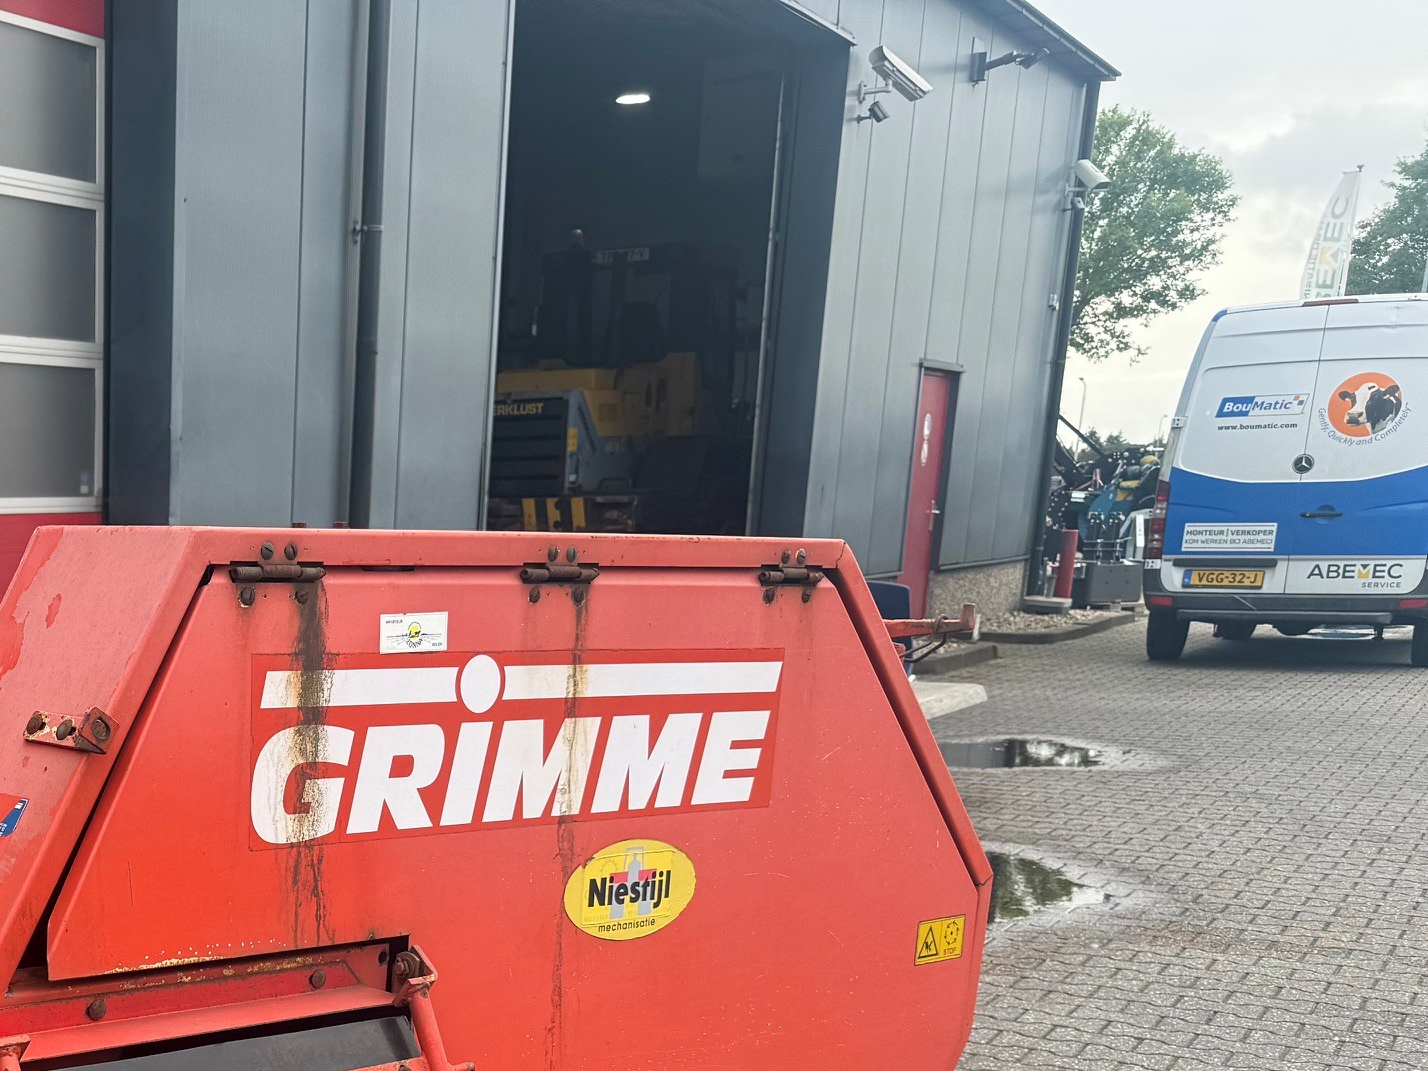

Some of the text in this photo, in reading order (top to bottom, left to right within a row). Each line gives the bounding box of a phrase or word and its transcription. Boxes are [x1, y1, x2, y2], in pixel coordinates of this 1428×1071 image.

[1222, 399, 1293, 413] BouMatic
[1217, 422, 1298, 431] www.boumatic.com
[1327, 430, 1355, 446] Quickly
[1355, 437, 1372, 446] and
[1185, 529, 1275, 537] MONTEUR VERKOPER
[1197, 571, 1258, 585] VGG-32-J
[1306, 562, 1404, 580] ABEMEC
[1361, 581, 1402, 589] SERVICE
[250, 654, 772, 845] GRIMME
[587, 869, 672, 909] Niestijl
[597, 917, 656, 933] mechanisatie
